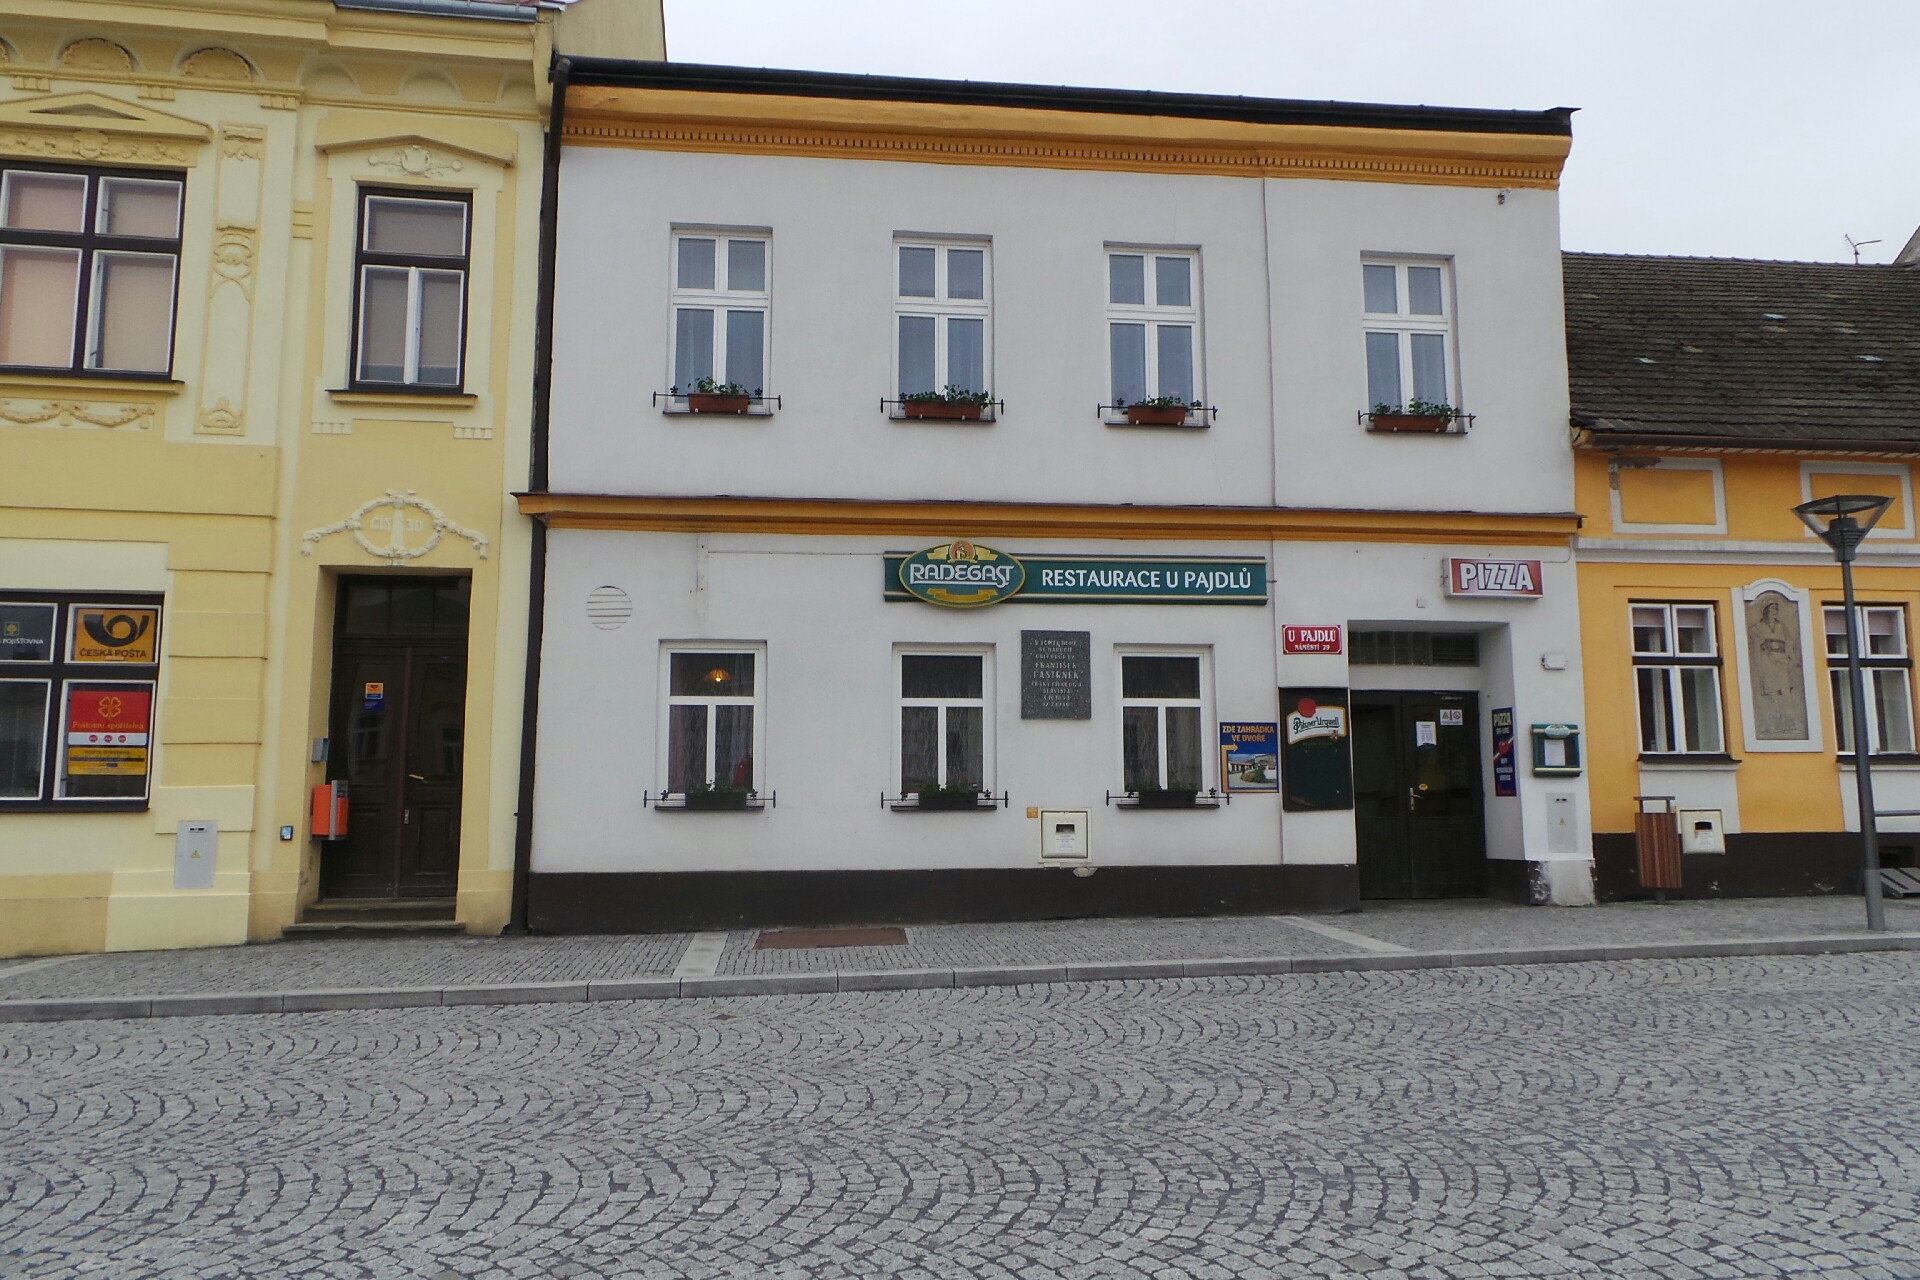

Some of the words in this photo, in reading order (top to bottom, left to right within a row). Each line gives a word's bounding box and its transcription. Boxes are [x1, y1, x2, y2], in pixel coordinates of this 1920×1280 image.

[909, 563, 1014, 588] RADEGAST
[1042, 569, 1161, 588] RESTAURACE
[1166, 572, 1179, 588] U
[1184, 567, 1252, 593] PAJDLŮ
[1459, 562, 1535, 590] PIZZA
[1288, 630, 1295, 642] U
[1300, 629, 1336, 642] PAJDLŮ
[114, 648, 147, 658] POŠTA
[1222, 725, 1236, 733] ZDE
[1237, 724, 1275, 734] ZAHRÁDKA
[1293, 717, 1317, 735] Pilsner
[1315, 716, 1340, 730] Urquell
[1231, 734, 1241, 742] VE
[1242, 733, 1266, 742] DVOŘE
